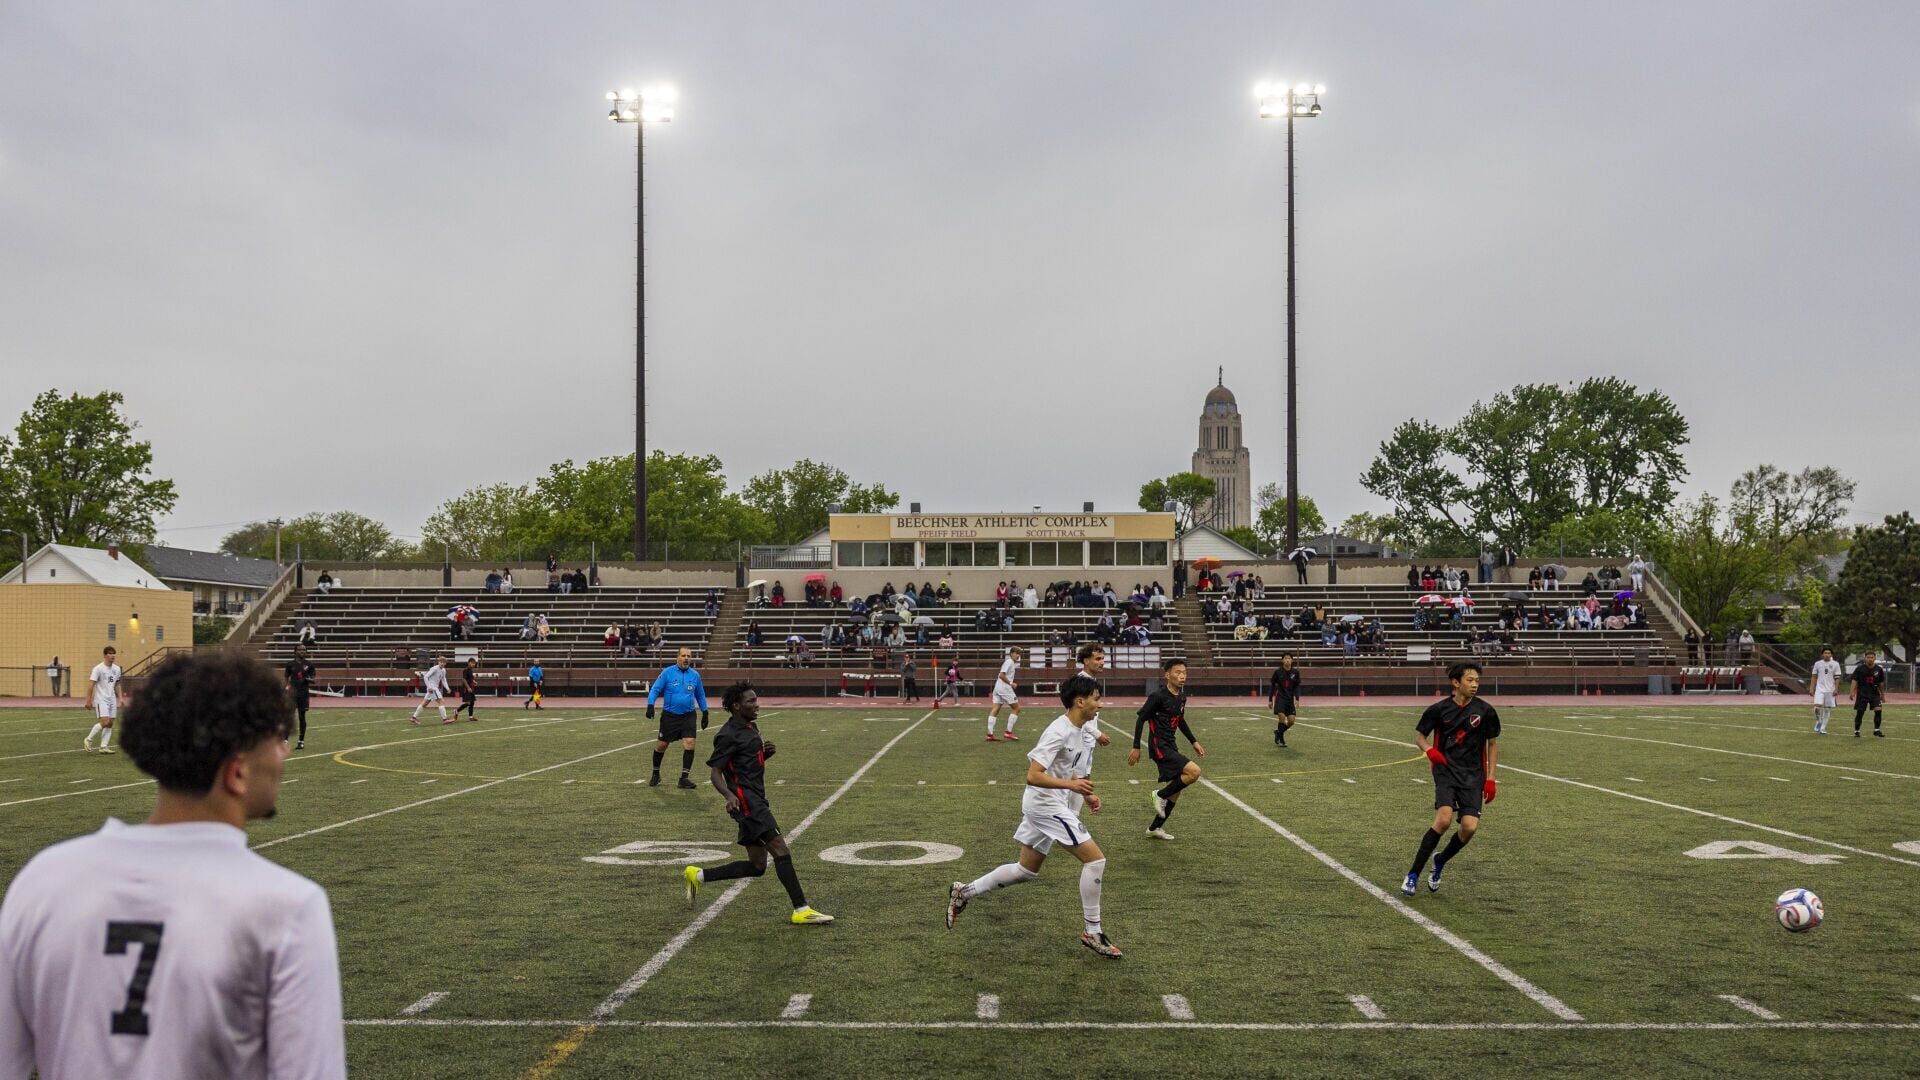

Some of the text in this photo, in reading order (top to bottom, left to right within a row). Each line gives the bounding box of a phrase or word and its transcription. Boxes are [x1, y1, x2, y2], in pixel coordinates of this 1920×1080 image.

[897, 516, 1108, 528] BEECHNER ATHLETIC COMPLEX
[919, 530, 977, 538] PFEIFF FIELD
[1026, 529, 1086, 538] SCOTT TRACK
[104, 921, 165, 1036] 7
